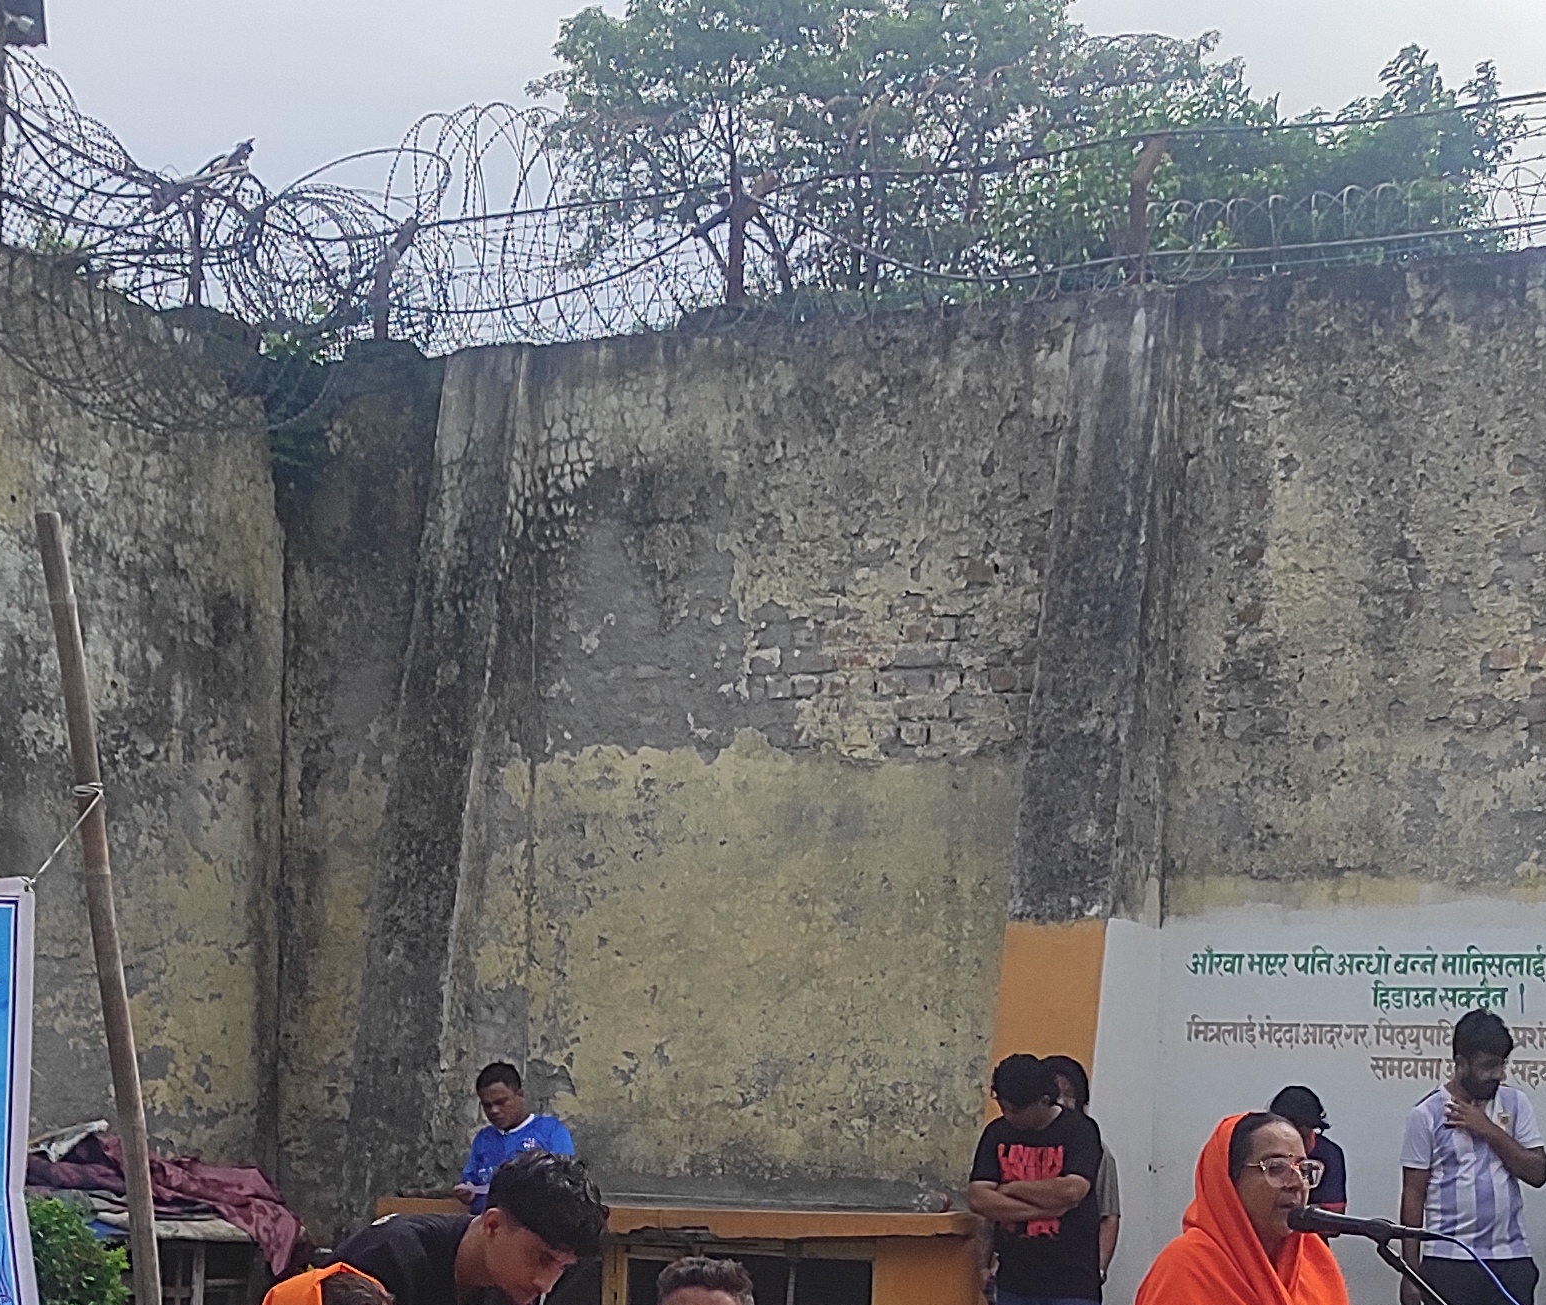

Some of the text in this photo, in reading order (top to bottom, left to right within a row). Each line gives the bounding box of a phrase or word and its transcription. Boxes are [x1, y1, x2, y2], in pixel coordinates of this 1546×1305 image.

[1291, 945, 1334, 976] पनि
[1186, 1014, 1257, 1049] मित्रलाई
[1300, 1024, 1344, 1050] आदर
[1370, 1056, 1442, 1081] समयमा
